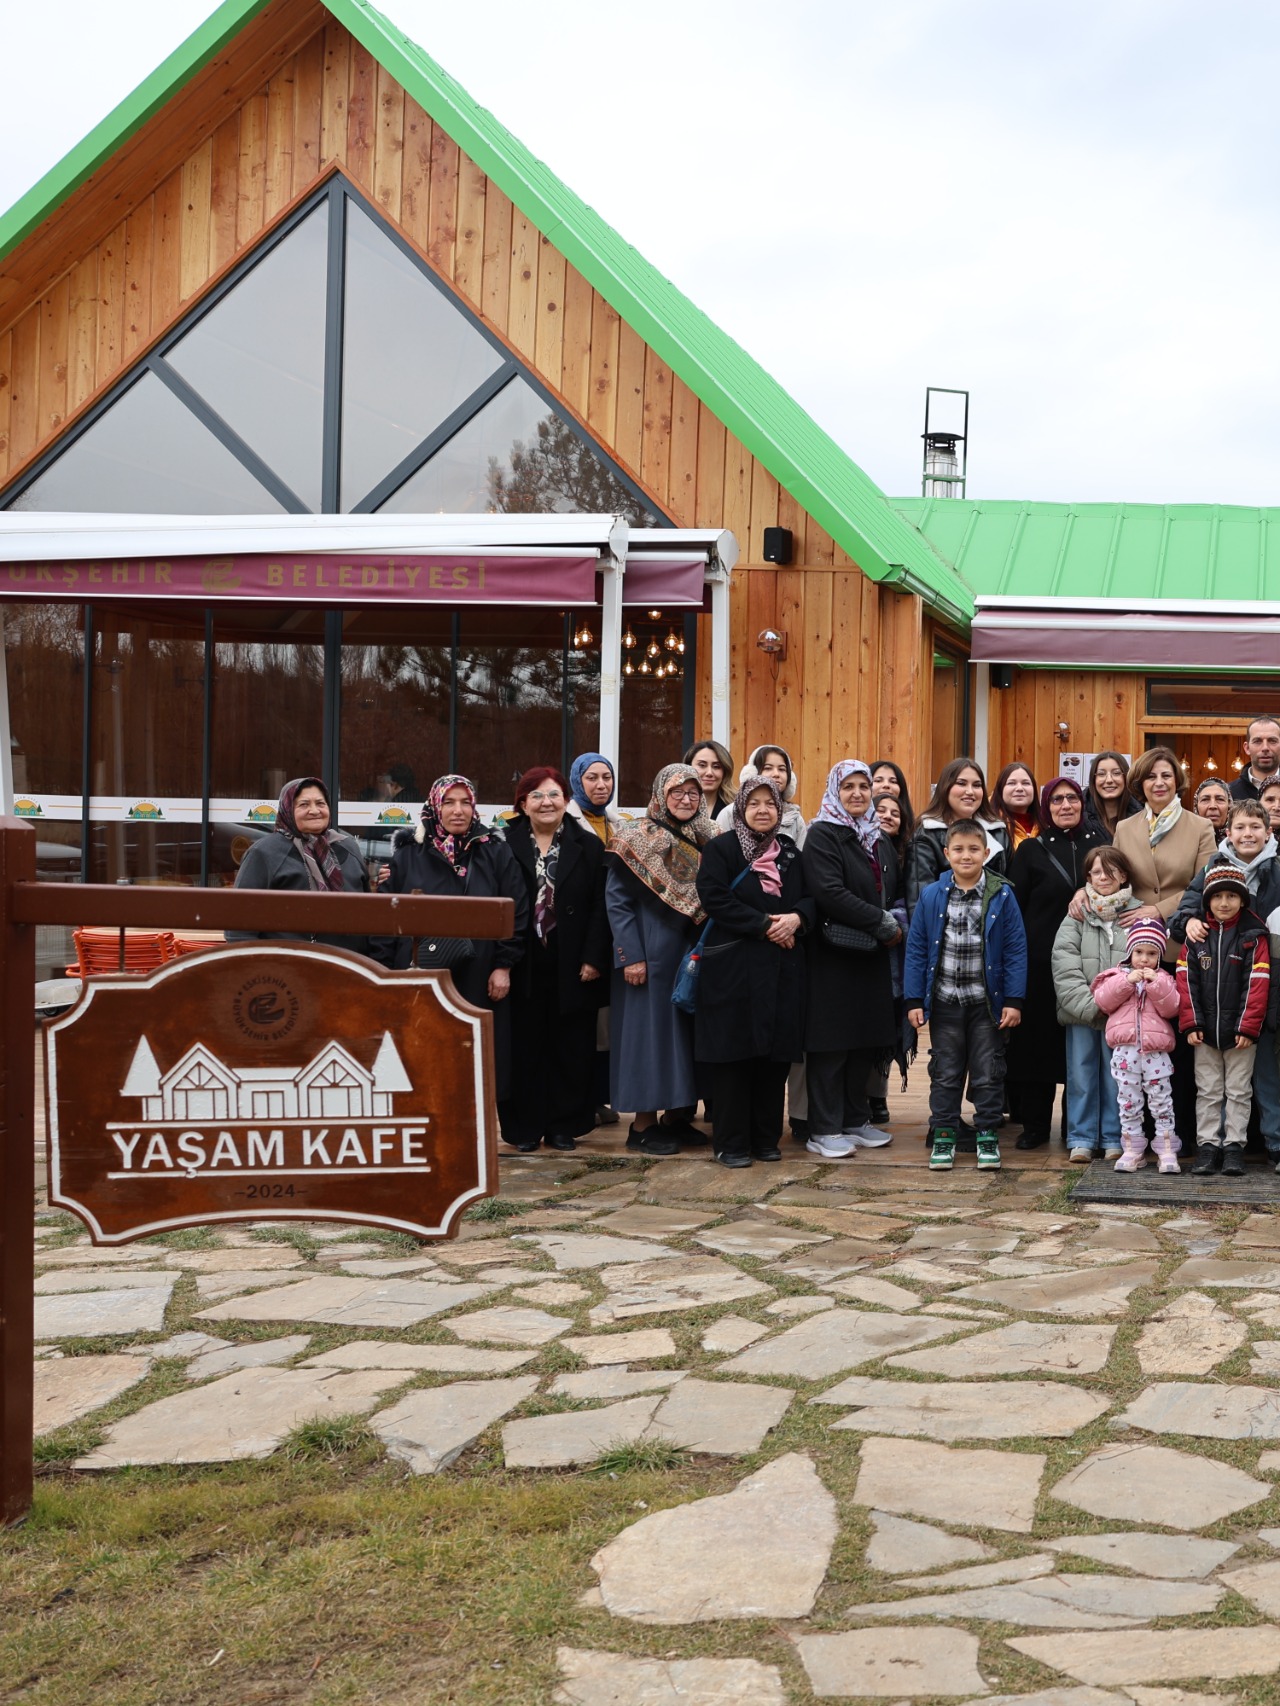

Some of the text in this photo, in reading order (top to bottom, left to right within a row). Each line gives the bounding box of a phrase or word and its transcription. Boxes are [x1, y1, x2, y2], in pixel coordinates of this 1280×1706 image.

[267, 560, 486, 590] BELEDİYESİ
[111, 1127, 428, 1179] YAŞAM KAFE
